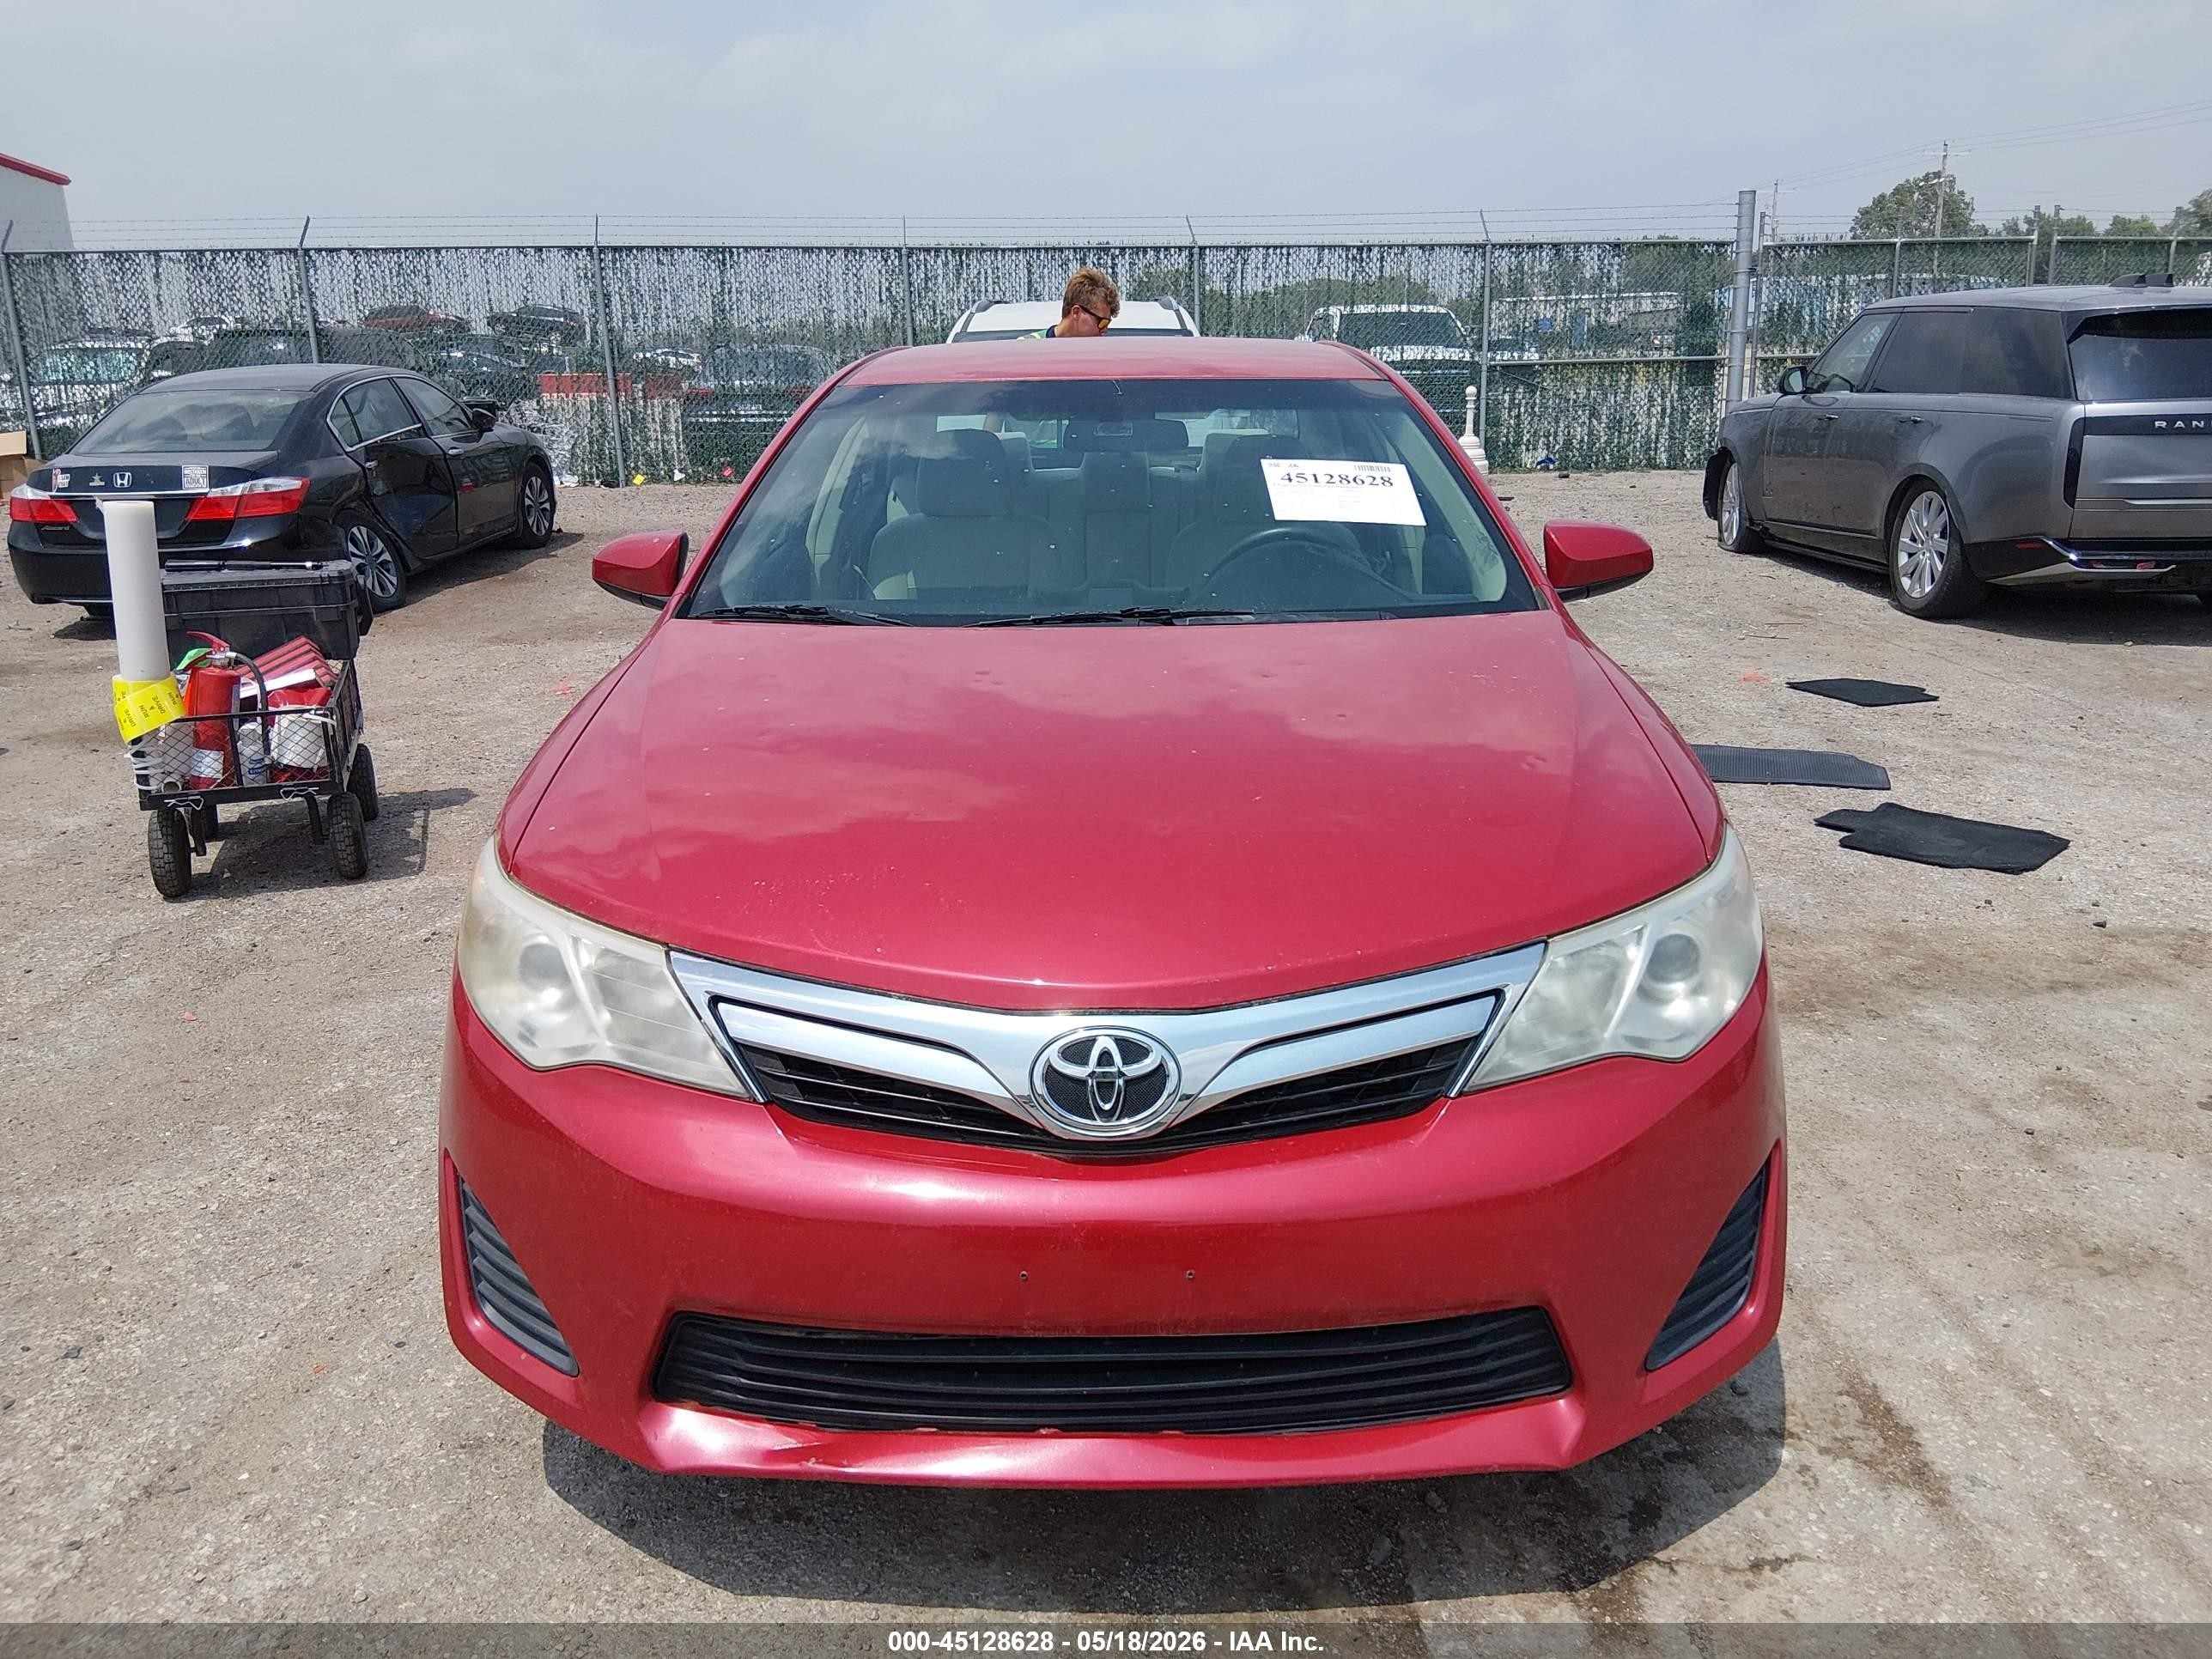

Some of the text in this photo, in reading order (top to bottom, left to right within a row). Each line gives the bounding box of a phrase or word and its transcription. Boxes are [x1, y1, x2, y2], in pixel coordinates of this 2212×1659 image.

[2154, 420, 2212, 428] RAN
[1280, 471, 1394, 488] 45128628
[138, 704, 150, 719] RUN
[151, 695, 166, 714] DRIVE
[124, 708, 137, 727] DRIVE
